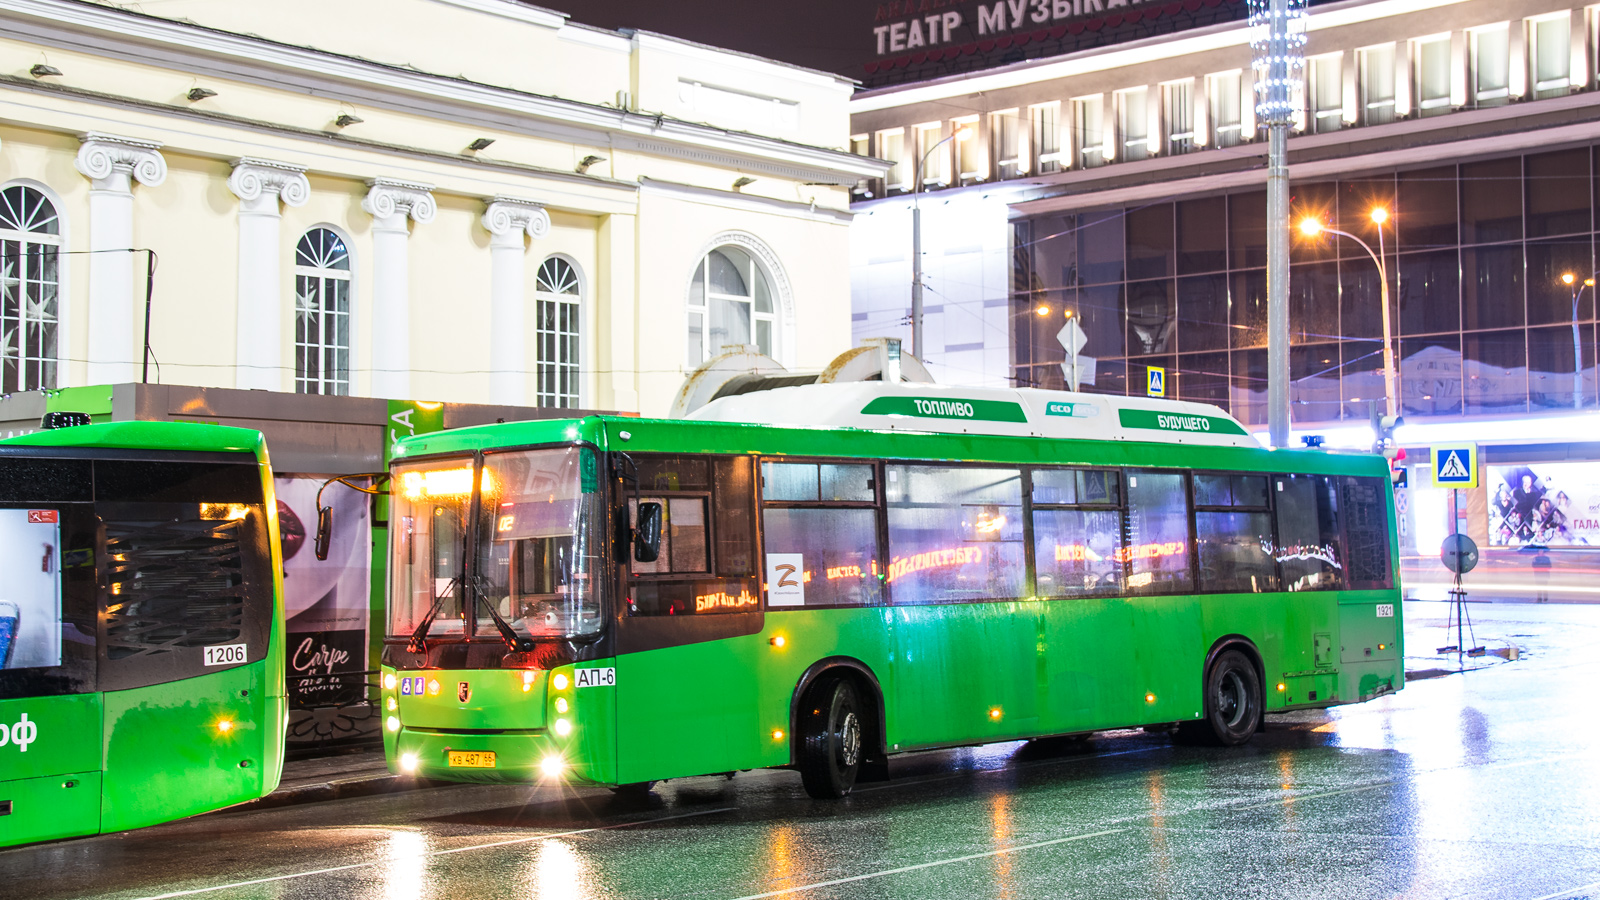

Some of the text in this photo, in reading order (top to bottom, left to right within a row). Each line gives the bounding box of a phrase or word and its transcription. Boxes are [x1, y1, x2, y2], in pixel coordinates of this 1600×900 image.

[873, 11, 962, 55] ТЕАТР
[914, 400, 1210, 431] ТОПЛИВО БУДУЩЕГО
[1573, 519, 1599, 530] ГАЛА
[775, 563, 799, 588] Z
[1377, 604, 1392, 616] 1921
[207, 646, 244, 663] 1206
[292, 637, 350, 675] Carpe
[577, 668, 614, 686] АП-6
[465, 753, 480, 765] 487
[484, 753, 493, 762] 66
